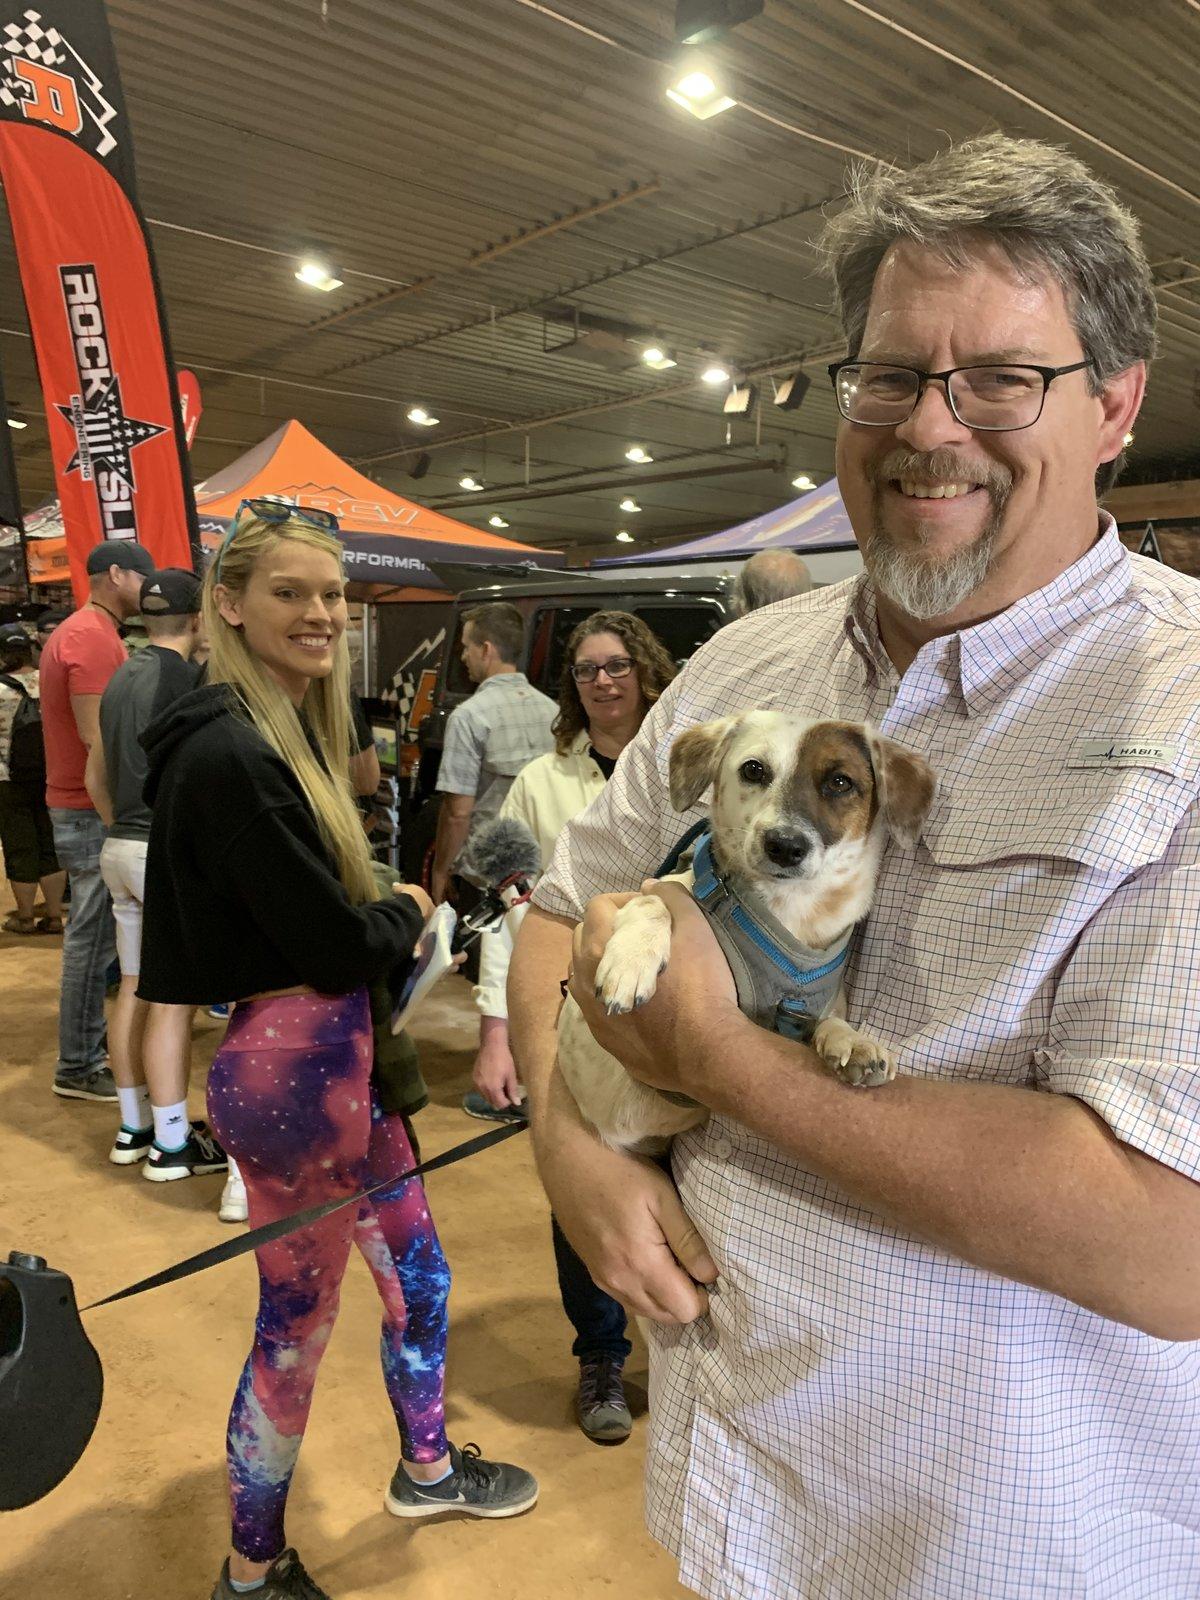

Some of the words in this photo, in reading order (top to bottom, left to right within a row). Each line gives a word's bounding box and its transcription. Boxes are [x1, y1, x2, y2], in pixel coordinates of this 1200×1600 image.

[63, 272, 111, 401] ROCK
[100, 471, 137, 543] SLI
[72, 395, 91, 480] ENGINEERING
[1119, 747, 1161, 757] HABIT
